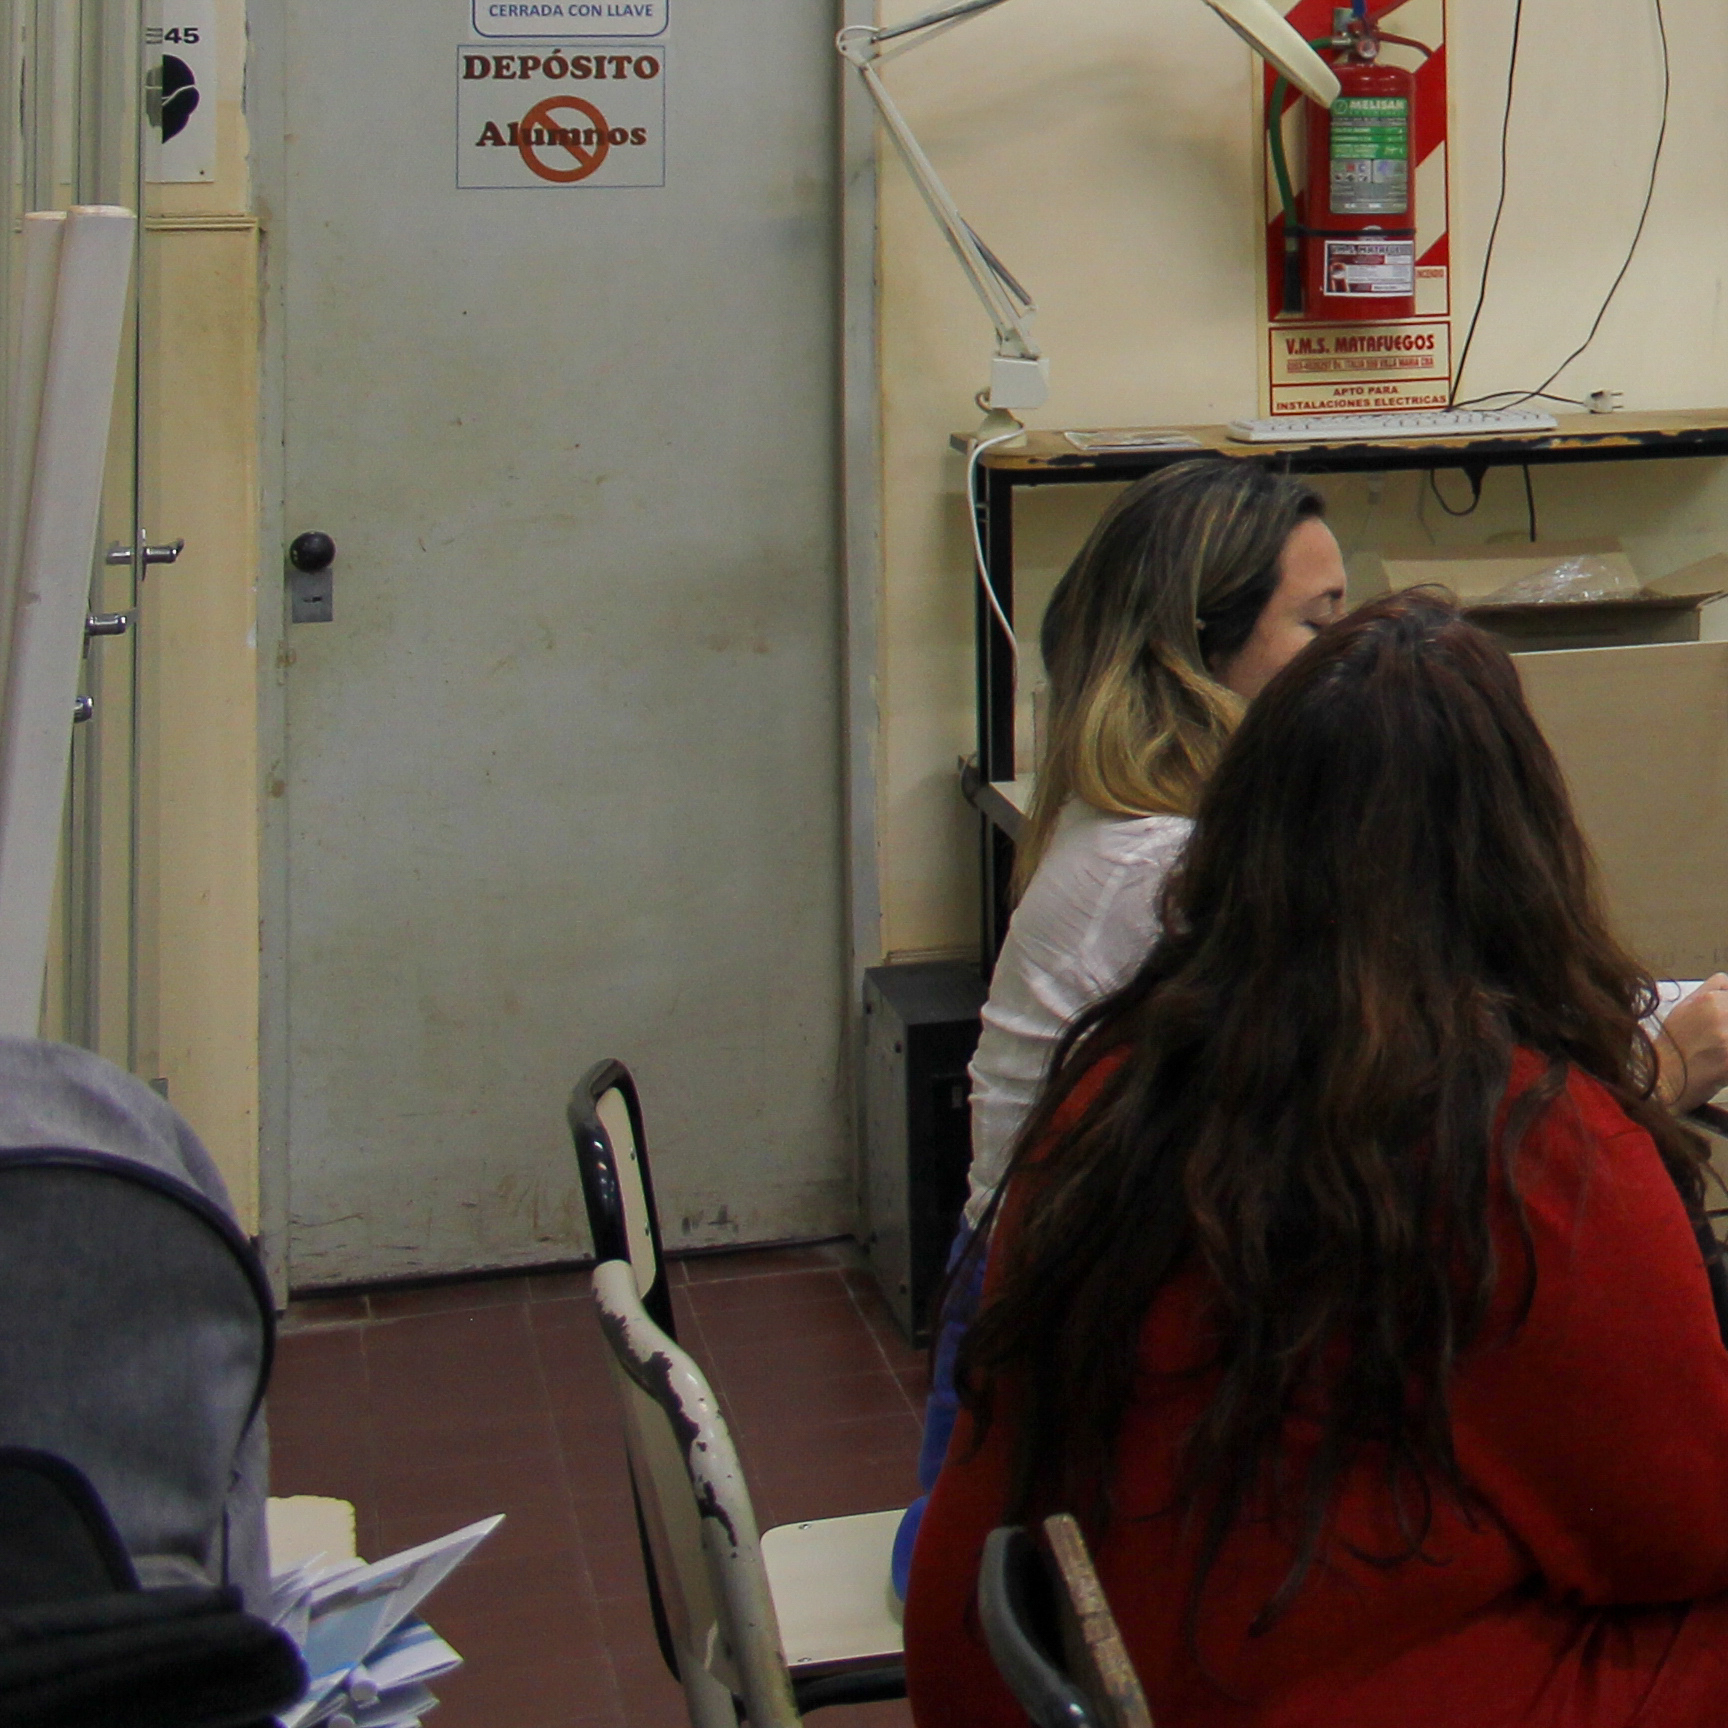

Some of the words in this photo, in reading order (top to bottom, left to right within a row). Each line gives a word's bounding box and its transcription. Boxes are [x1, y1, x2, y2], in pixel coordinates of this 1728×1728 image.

[489, 3, 564, 18] CERRADA
[568, 3, 603, 17] CON
[607, 3, 654, 17] LLAVE
[461, 48, 661, 80] DEPÓSITO
[475, 121, 648, 147] Alumnos
[1285, 336, 1330, 355] V.M.S.
[1335, 333, 1436, 354] MATAFUEGOS
[1332, 386, 1365, 396] APTO
[1367, 385, 1399, 395] PARA
[1276, 398, 1371, 411] INSTALACIONES
[1374, 394, 1447, 407] ELECTRICAS
